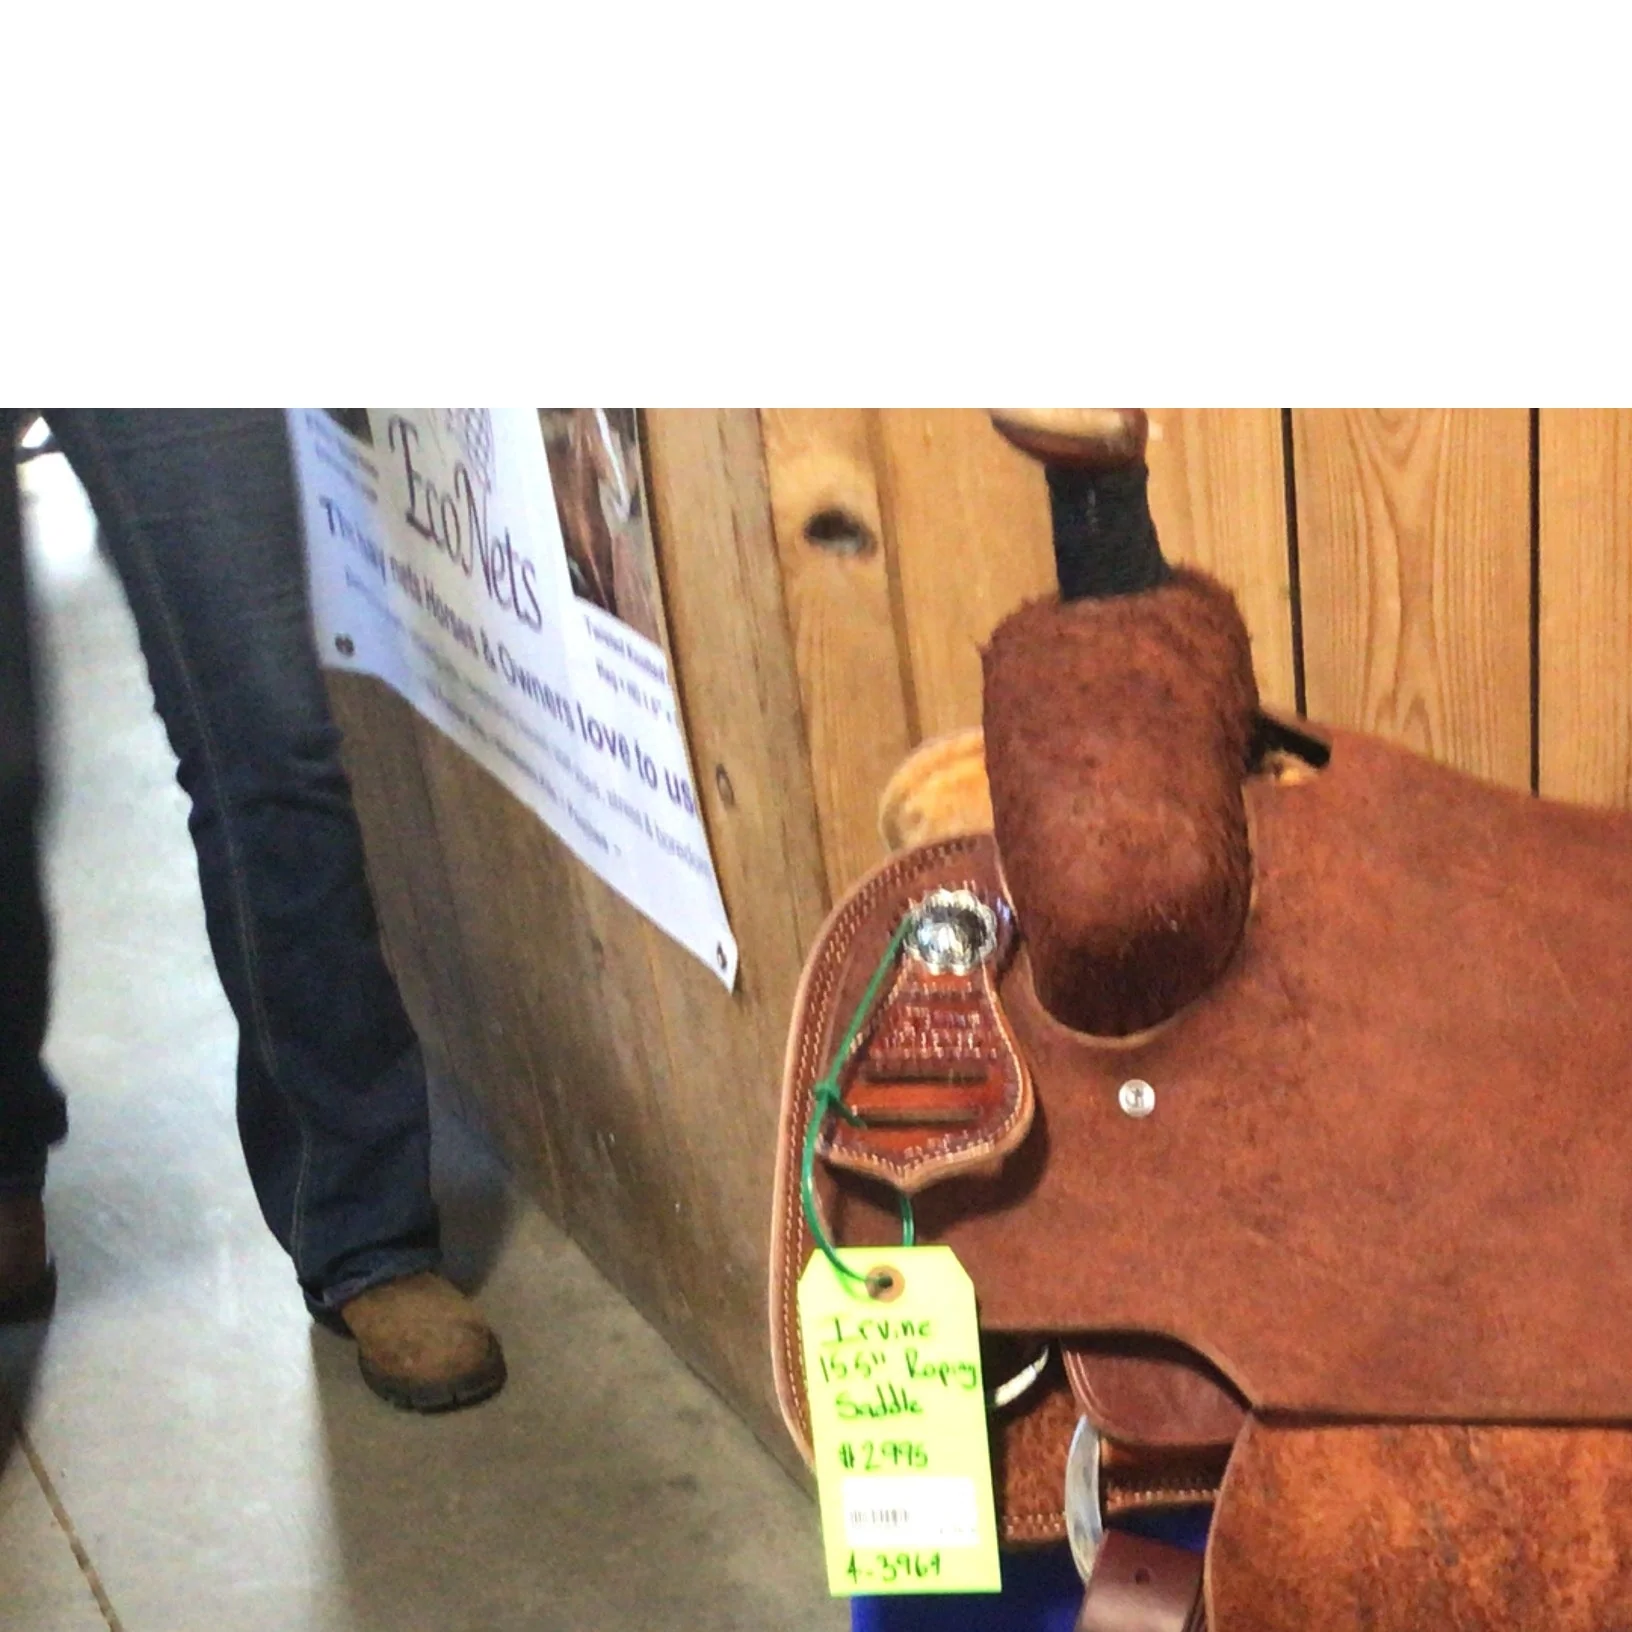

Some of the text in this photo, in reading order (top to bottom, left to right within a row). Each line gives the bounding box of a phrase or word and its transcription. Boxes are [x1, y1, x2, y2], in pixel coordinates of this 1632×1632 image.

[388, 414, 542, 632] EcoNets
[479, 626, 497, 673] &
[497, 642, 576, 734] Owners
[576, 700, 632, 771] love
[634, 736, 658, 790] to
[822, 1314, 932, 1346] Irvine
[904, 1348, 978, 1391] Roping
[836, 1381, 924, 1420] Saddle
